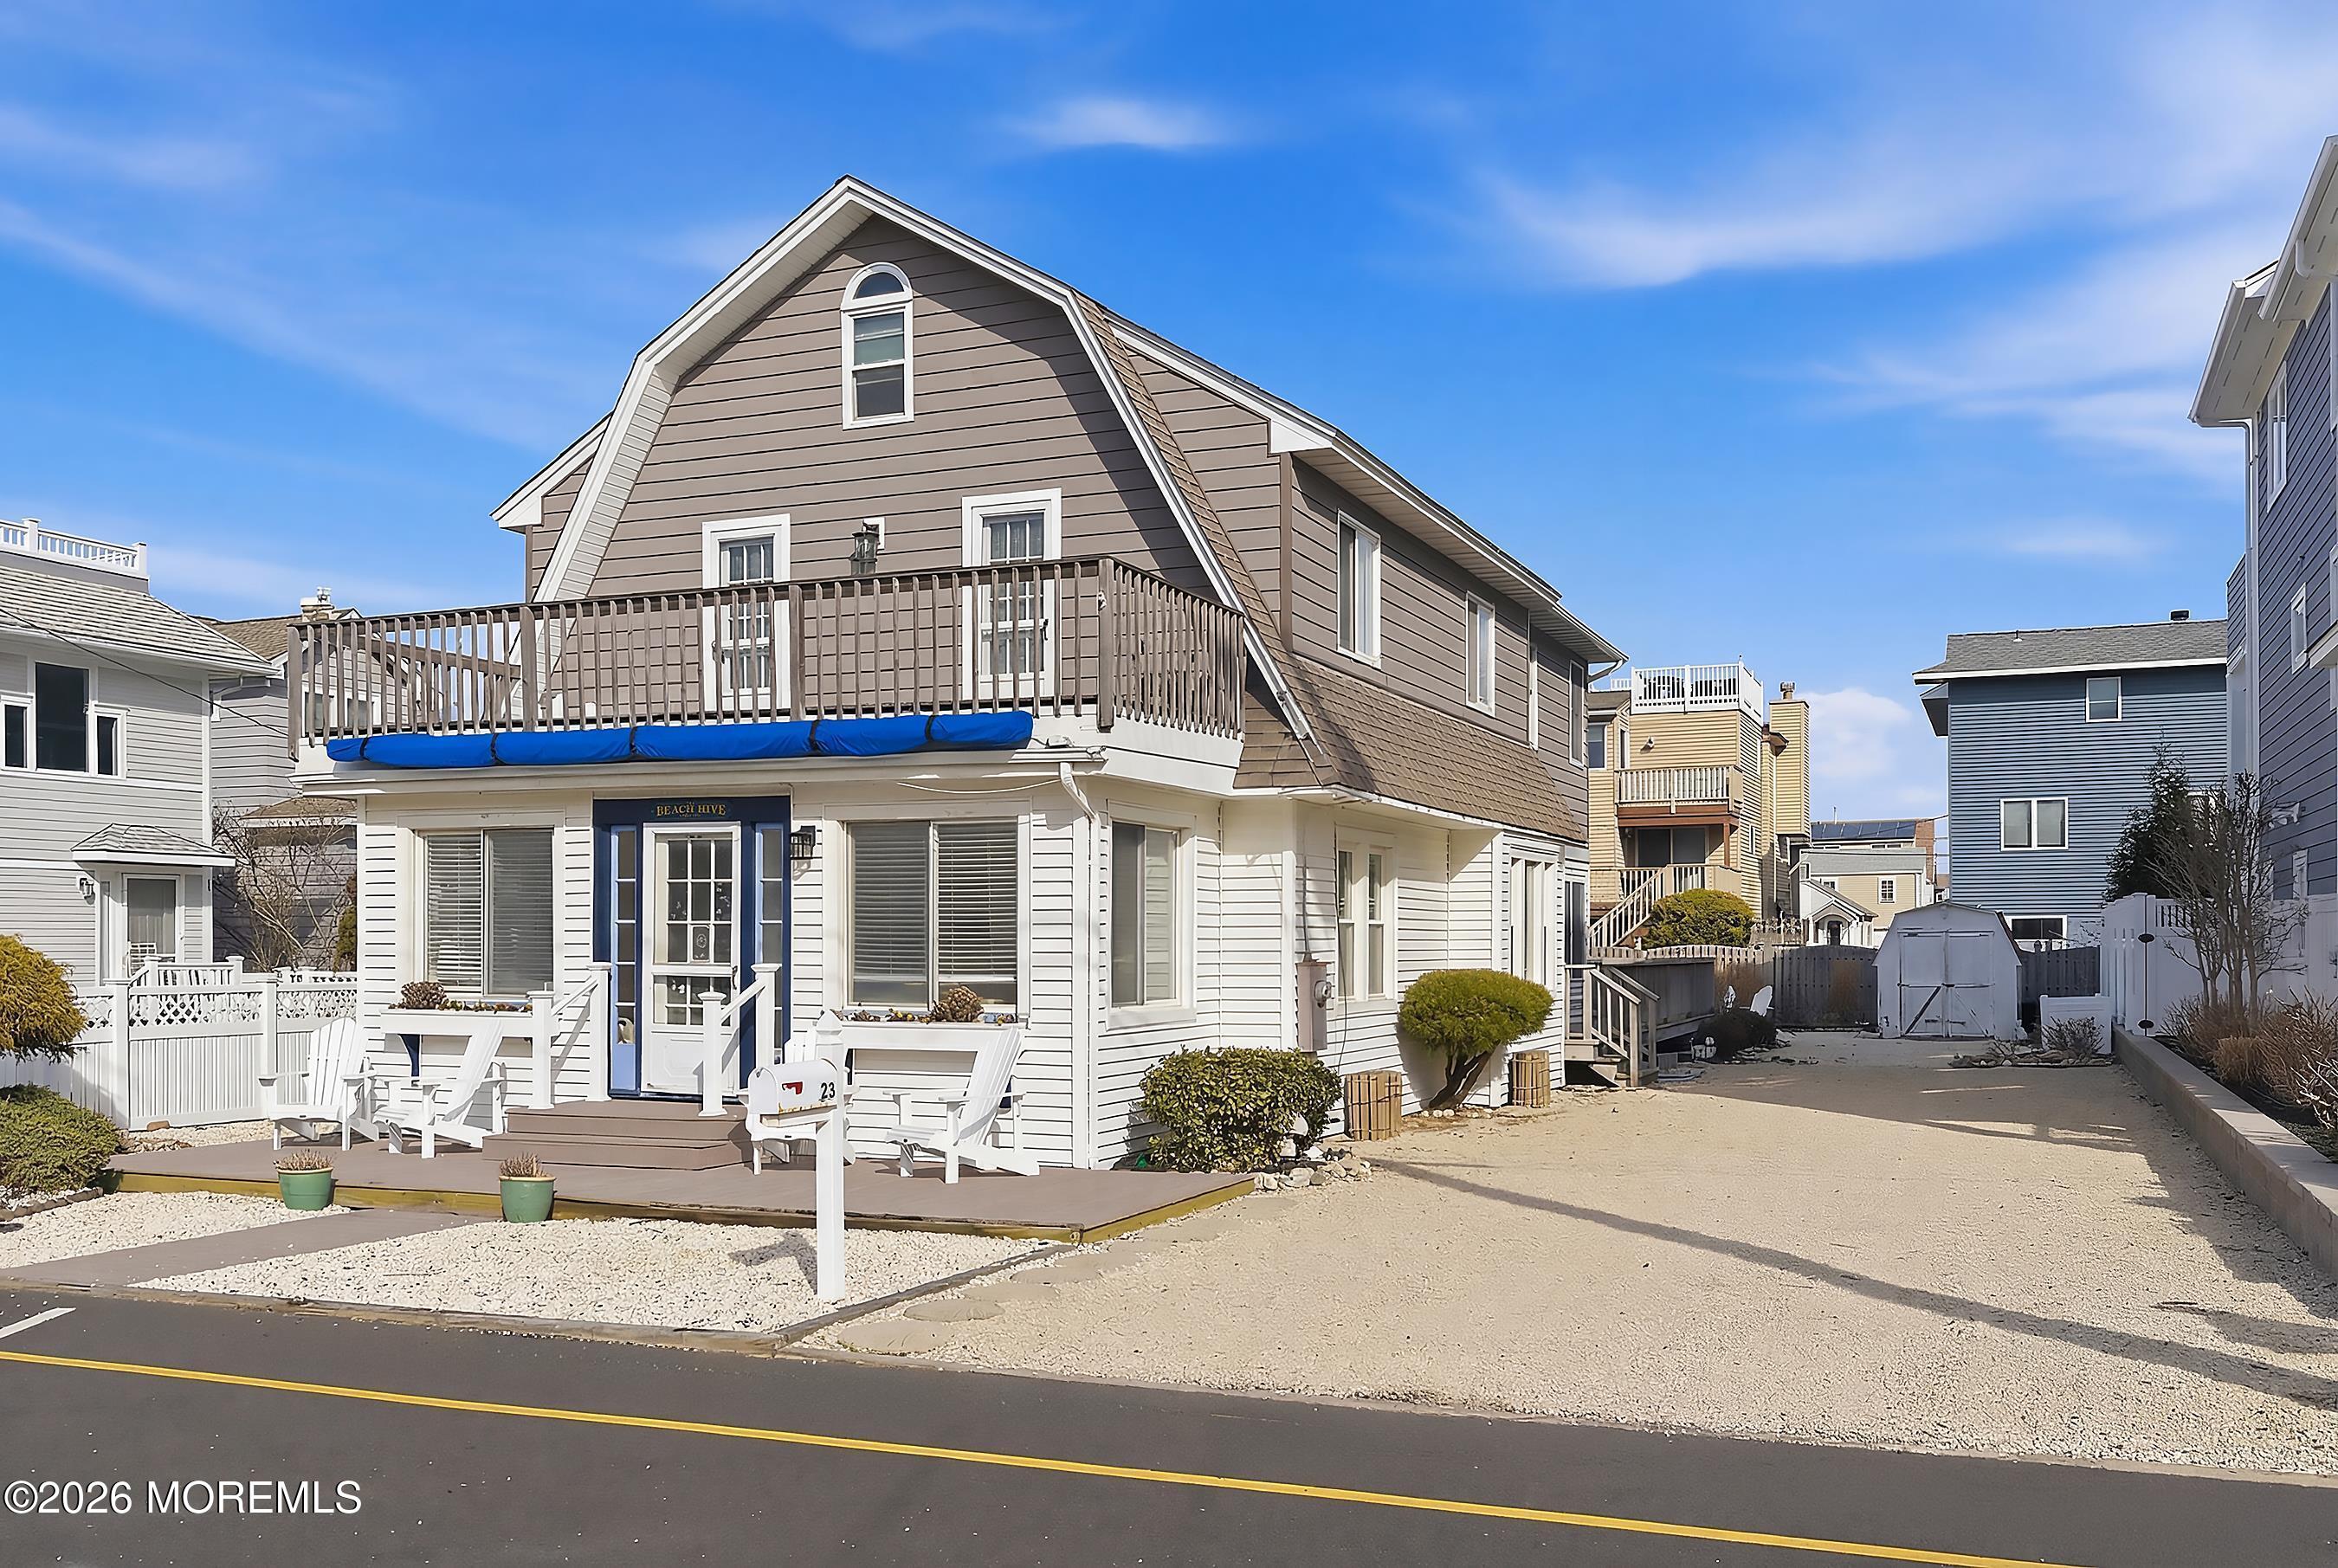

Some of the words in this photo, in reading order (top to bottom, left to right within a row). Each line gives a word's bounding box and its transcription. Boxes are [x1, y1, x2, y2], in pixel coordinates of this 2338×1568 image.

[656, 804, 694, 816] BEACH
[698, 804, 727, 816] HIVE
[821, 1081, 836, 1100] 23
